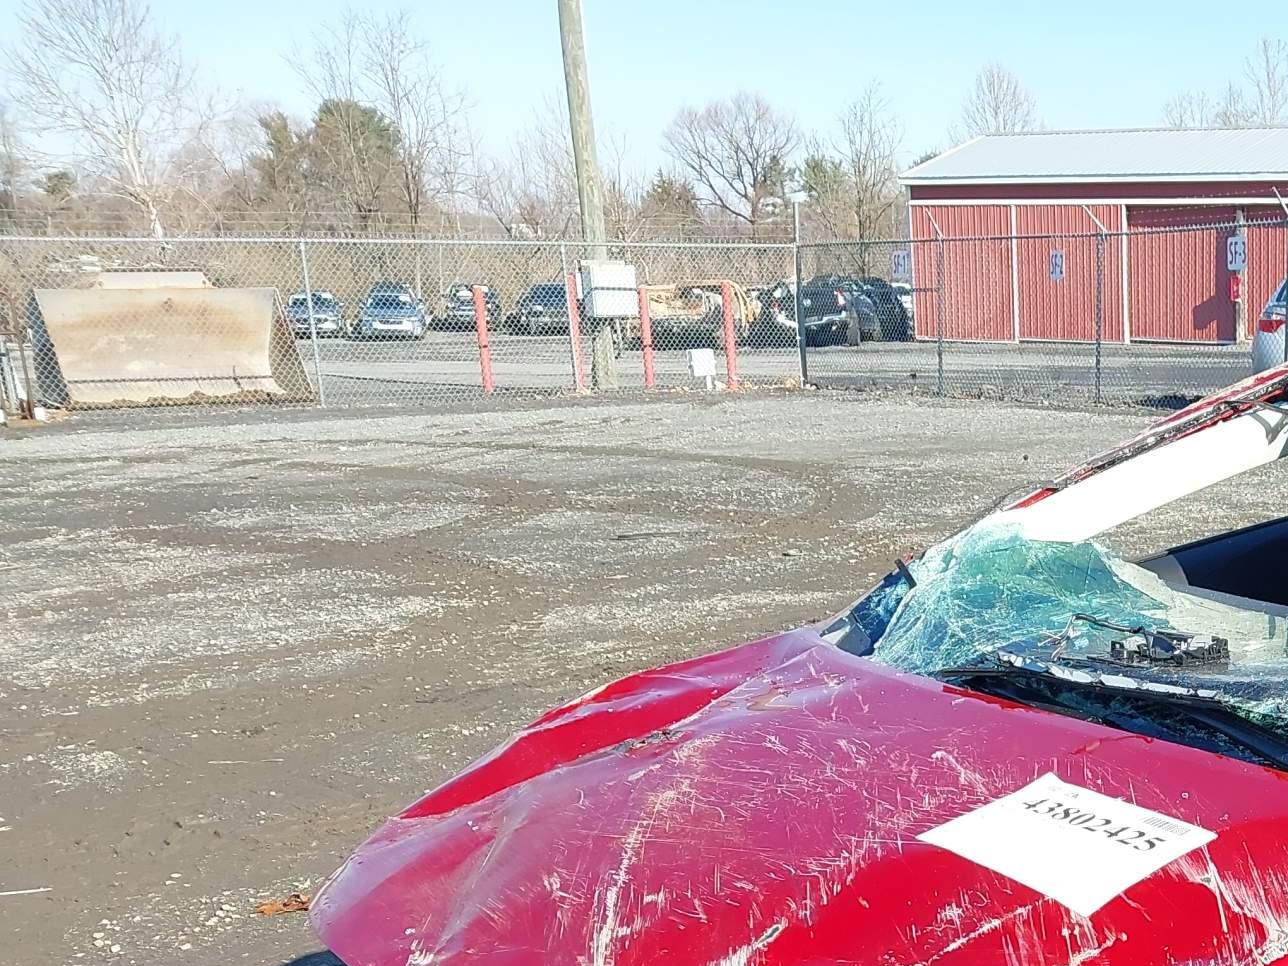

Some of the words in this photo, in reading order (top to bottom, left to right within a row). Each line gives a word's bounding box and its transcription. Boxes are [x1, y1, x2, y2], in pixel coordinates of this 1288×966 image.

[893, 254, 906, 274] SF-1
[1229, 241, 1246, 265] SF-3
[1050, 254, 1063, 275] SF-2
[1022, 799, 1167, 851] 43802425
